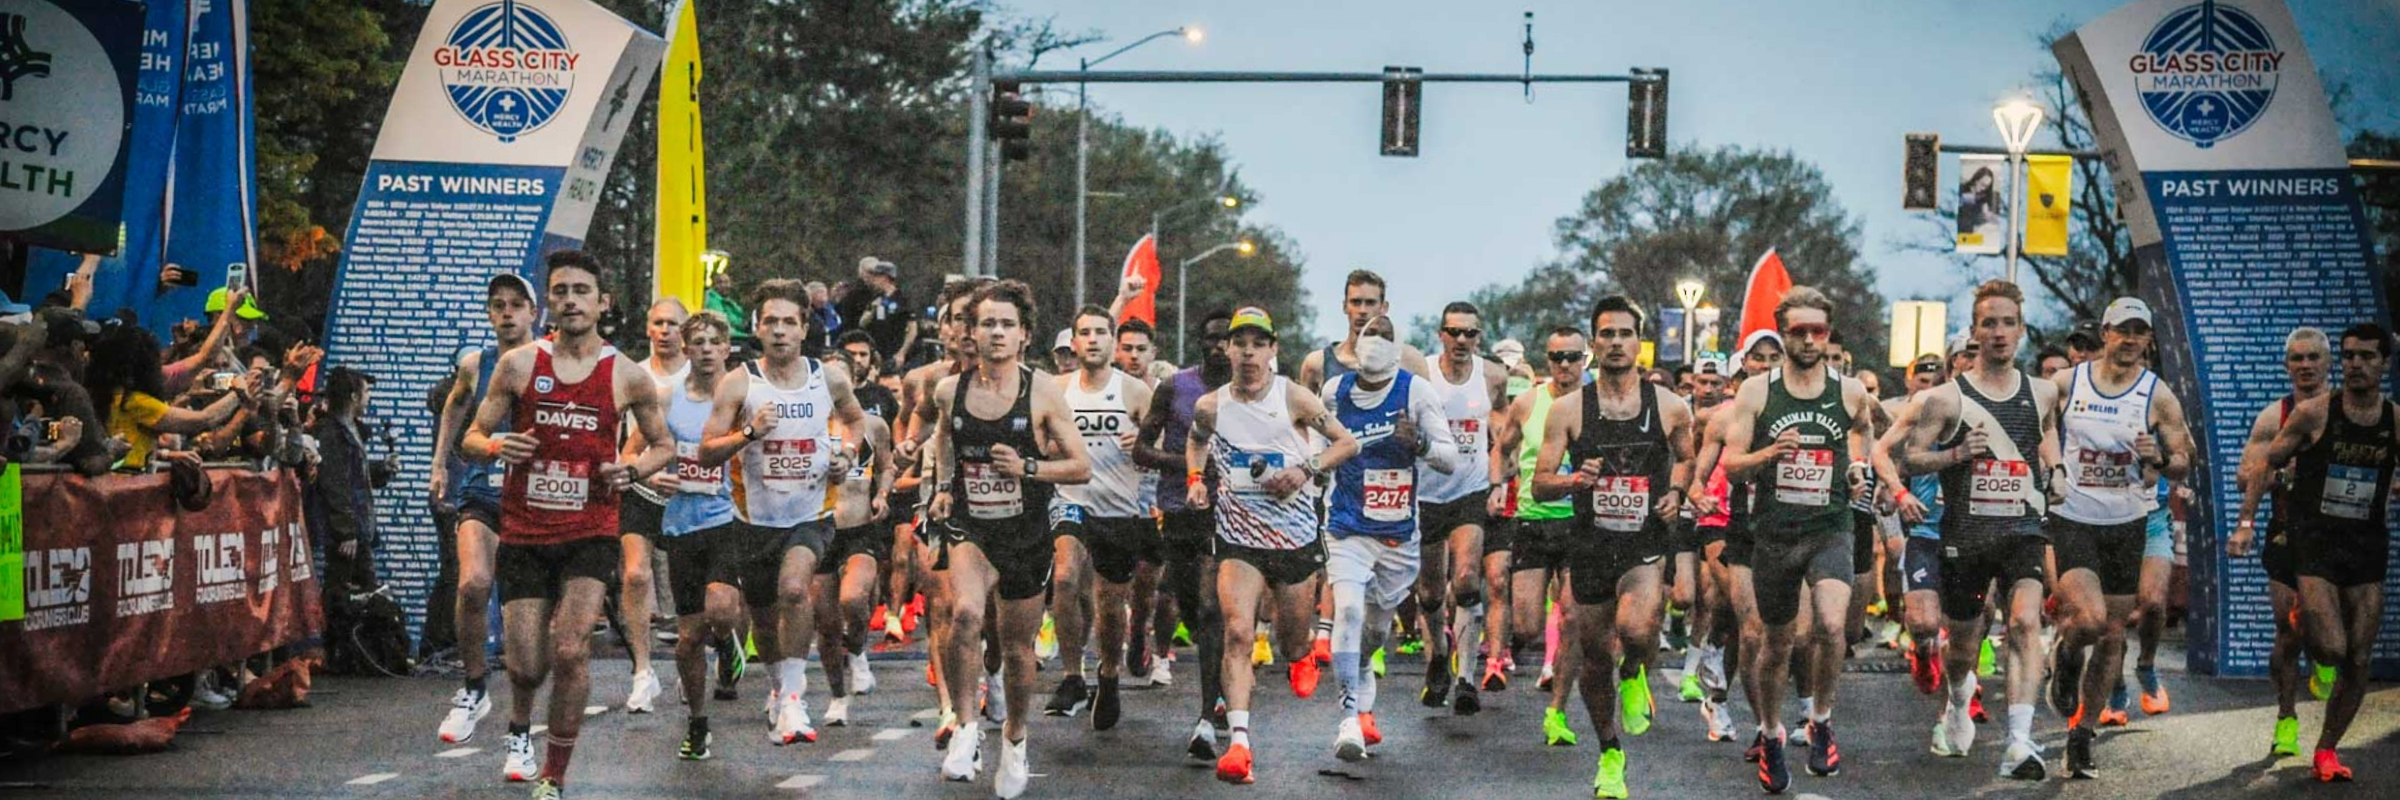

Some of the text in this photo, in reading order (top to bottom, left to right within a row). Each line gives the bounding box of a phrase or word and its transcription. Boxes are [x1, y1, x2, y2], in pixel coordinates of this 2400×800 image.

[434, 47, 580, 71] GLASS CITY
[2130, 52, 2285, 74] GLASS CITY
[456, 68, 560, 86] MARATHON
[2153, 74, 2262, 91] MARATHON
[378, 175, 545, 196] PAST WINNERS
[2162, 178, 2339, 197] PAST WINNERS
[777, 402, 813, 419] OLEDO
[2087, 403, 2119, 415] HELIOS
[535, 410, 599, 431] DAVE'S
[1768, 411, 1844, 441] MERRIMAN VALLEY
[1452, 434, 1475, 446] 003
[769, 456, 812, 469] 2025
[1782, 466, 1826, 482] 2027
[2082, 465, 2126, 478] 2004
[534, 477, 580, 494] 2001
[968, 480, 1016, 495] 2040
[1976, 477, 2021, 492] 2026
[2345, 482, 2357, 496] 2
[1364, 490, 1411, 507] 2474
[1597, 493, 1644, 508] 2009
